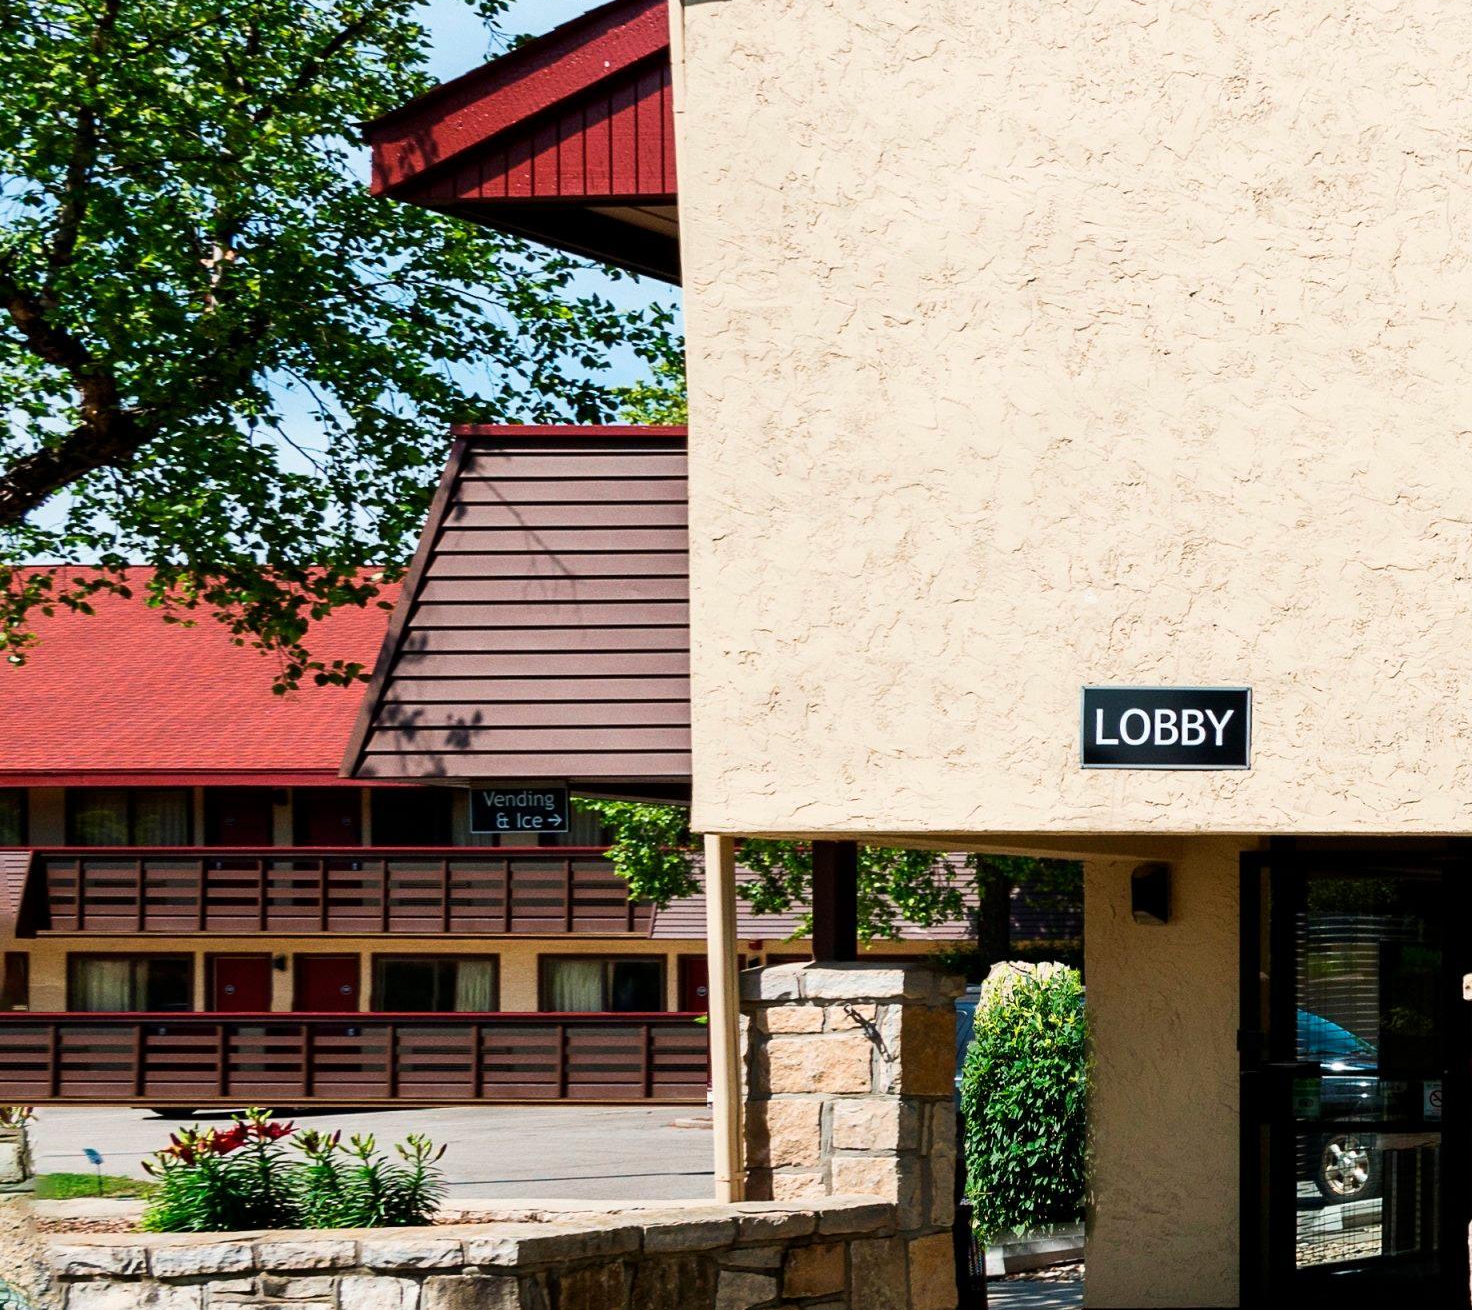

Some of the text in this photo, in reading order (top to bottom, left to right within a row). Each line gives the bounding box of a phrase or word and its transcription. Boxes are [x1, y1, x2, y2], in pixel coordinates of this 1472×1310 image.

[1095, 707, 1235, 747] LOBBY
[482, 790, 556, 811] Vending
[495, 812, 544, 829] & Ice
